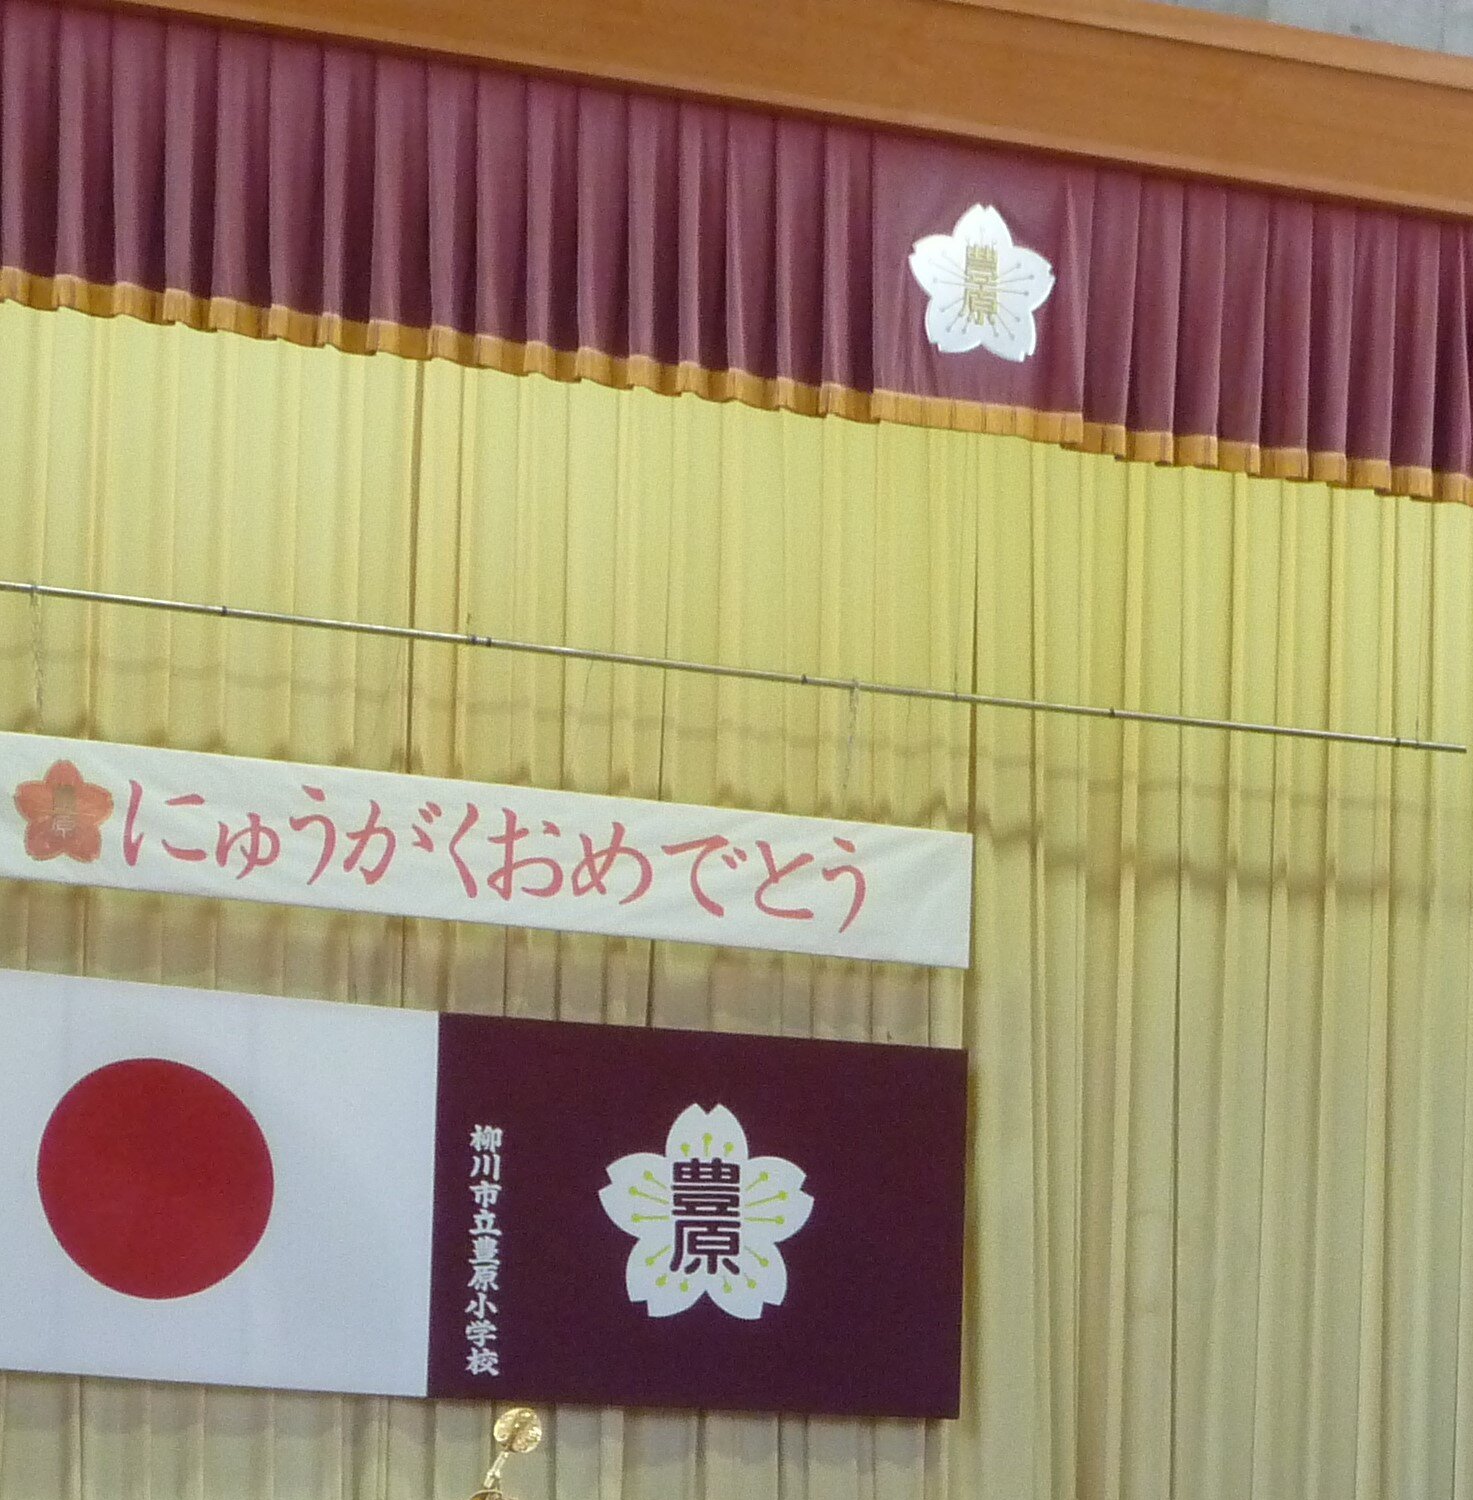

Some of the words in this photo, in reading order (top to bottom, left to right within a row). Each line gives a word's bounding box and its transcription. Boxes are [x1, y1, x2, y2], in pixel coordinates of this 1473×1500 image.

[122, 779, 868, 933] にゅうがくおめでとう
[465, 1124, 503, 1377] 柳川市立豊原小学校
[670, 1157, 741, 1275] 豊原
